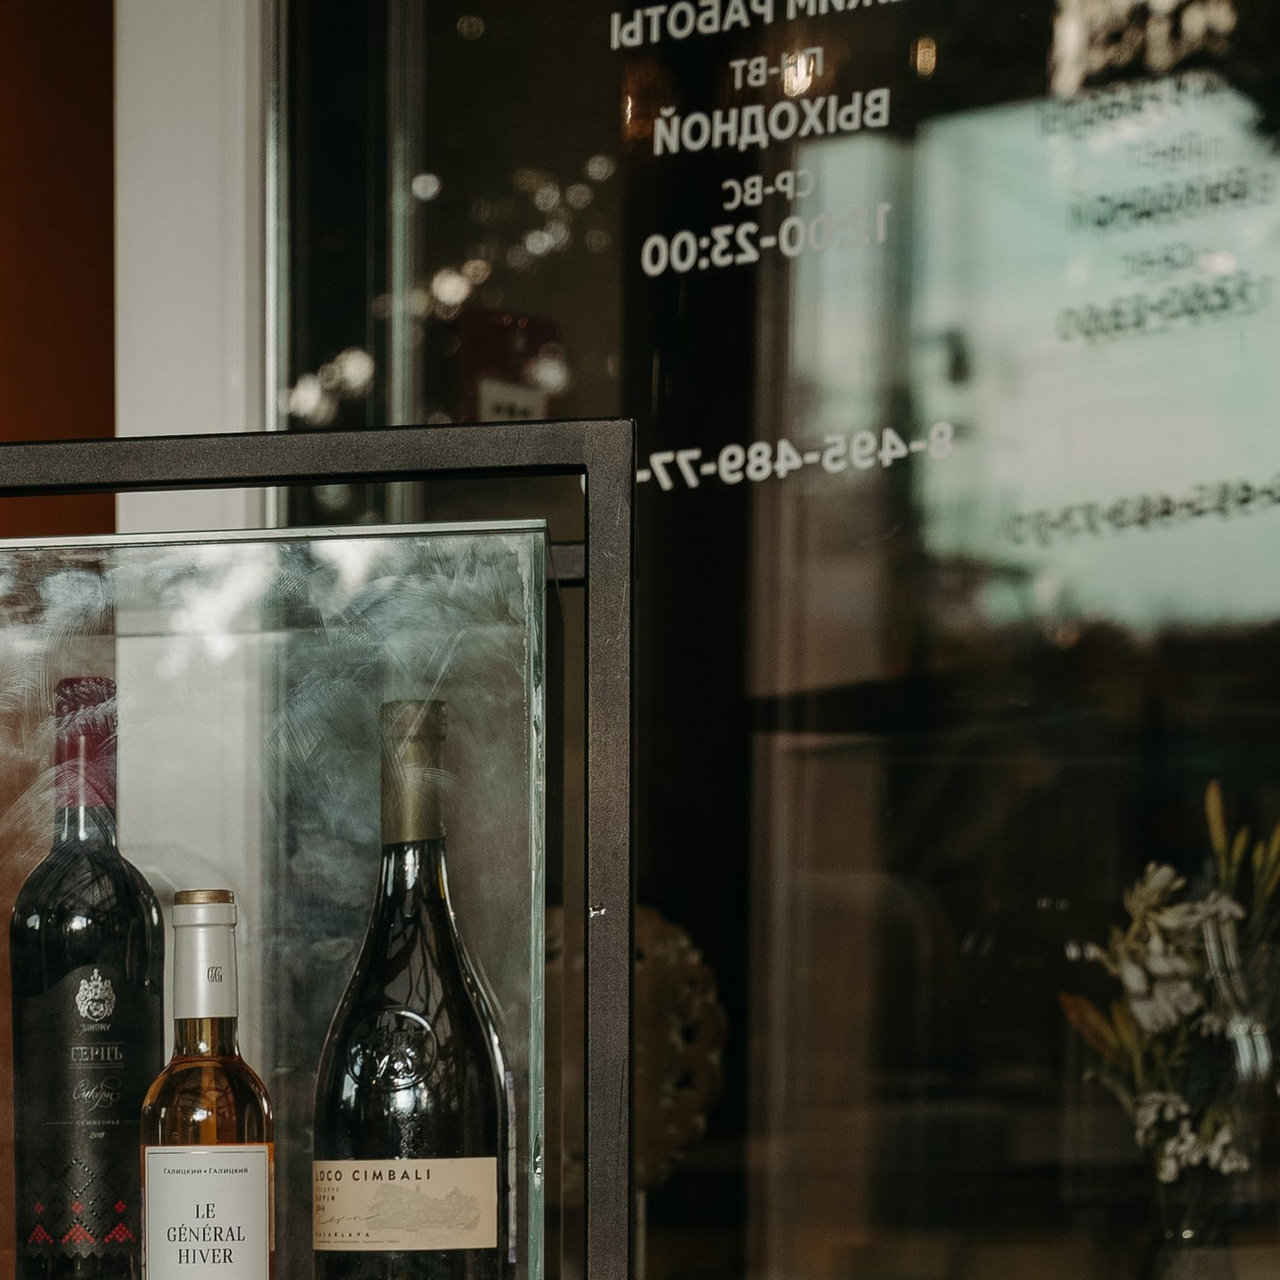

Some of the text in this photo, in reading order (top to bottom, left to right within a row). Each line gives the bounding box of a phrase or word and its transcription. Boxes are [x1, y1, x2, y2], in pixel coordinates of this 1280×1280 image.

[352, 1168, 431, 1181] CIMBALI
[195, 1203, 216, 1219] LE
[166, 1223, 246, 1243] GÉNÉRAL
[177, 1248, 234, 1264] HIVER
